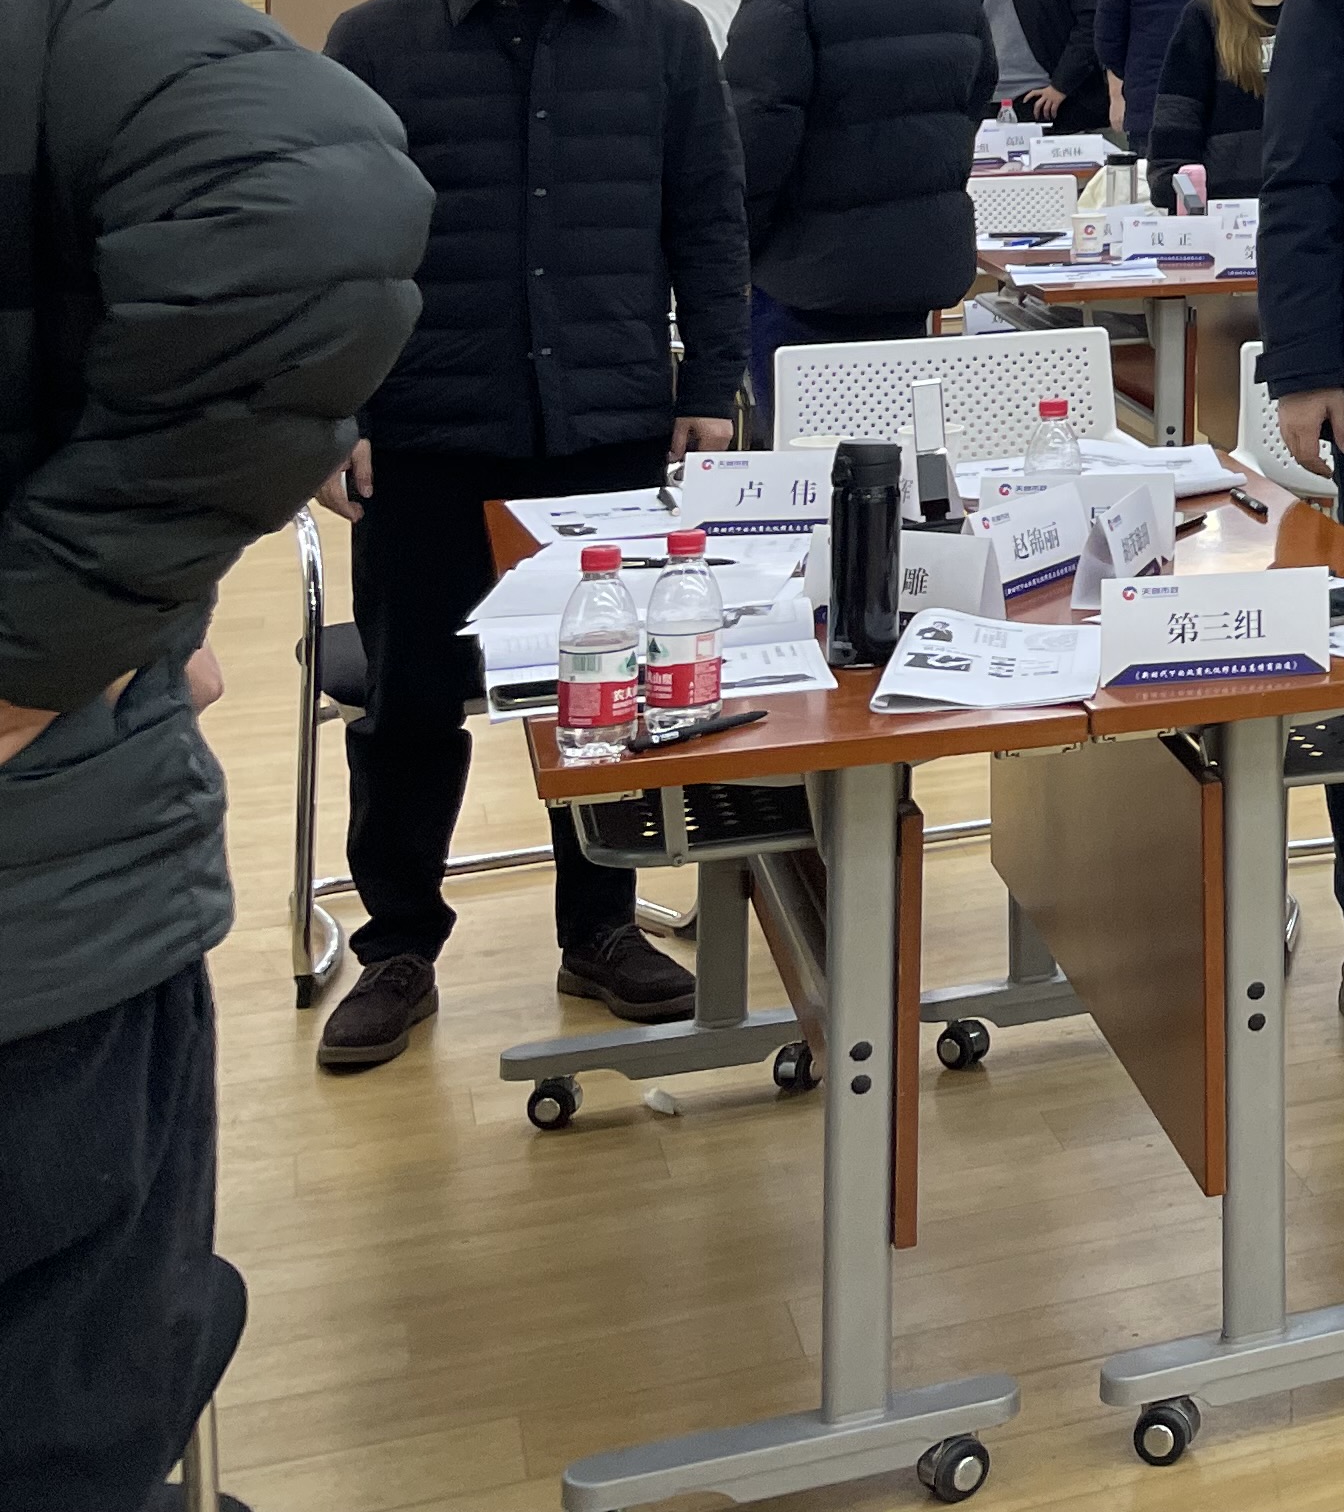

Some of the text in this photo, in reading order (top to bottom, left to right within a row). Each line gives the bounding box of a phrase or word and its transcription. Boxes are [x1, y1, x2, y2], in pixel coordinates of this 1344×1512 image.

[1012, 521, 1060, 561] 赵锦丽
[1167, 608, 1267, 645] 第三组
